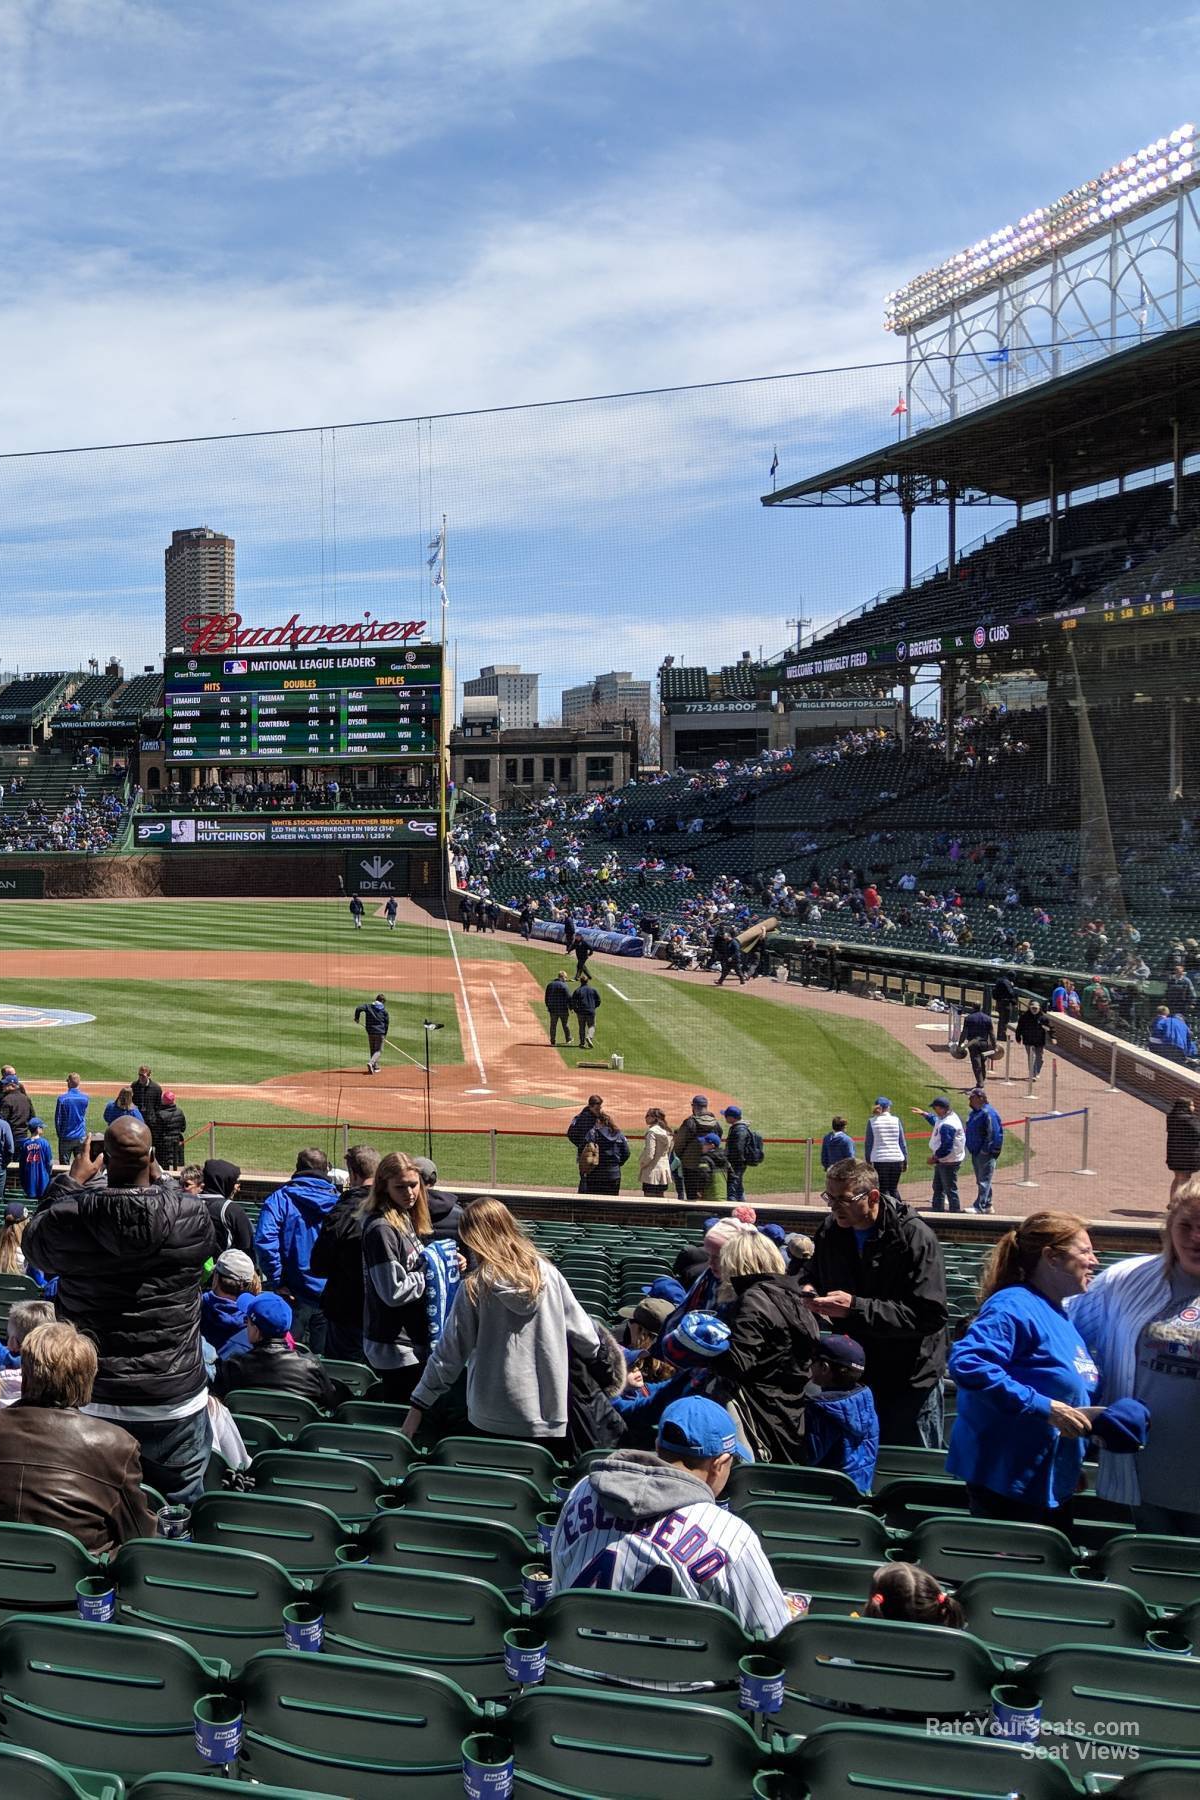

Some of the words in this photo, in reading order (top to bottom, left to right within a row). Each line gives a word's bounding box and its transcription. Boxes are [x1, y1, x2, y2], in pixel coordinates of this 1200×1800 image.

[182, 612, 426, 653] Budweiser
[909, 638, 942, 657] BREWERS
[988, 625, 1010, 642] CUBS
[251, 660, 297, 671] NATIONAL
[300, 659, 334, 670] LEAGUE
[337, 657, 376, 668] LEADERS
[786, 662, 814, 679] WELCOME
[814, 661, 823, 674] TO
[823, 656, 850, 673] WRIGLEY
[850, 652, 868, 668] FIELD
[283, 680, 317, 689] DOUBLES
[375, 676, 405, 685] TRIPLES
[204, 683, 221, 691] HITS
[685, 702, 757, 712] 773-248-ROOF
[795, 700, 895, 709] WRIGLEYROOFTOPS.COM
[197, 821, 220, 829] BILL
[197, 832, 266, 840] HUTCHINSON
[360, 881, 395, 890] IDEAL
[84, 1600, 102, 1608] Hefty
[300, 1623, 319, 1636] Hefty
[521, 1653, 541, 1662] Hefty
[214, 1728, 237, 1741] Hefty
[484, 1770, 508, 1782] Hefty
